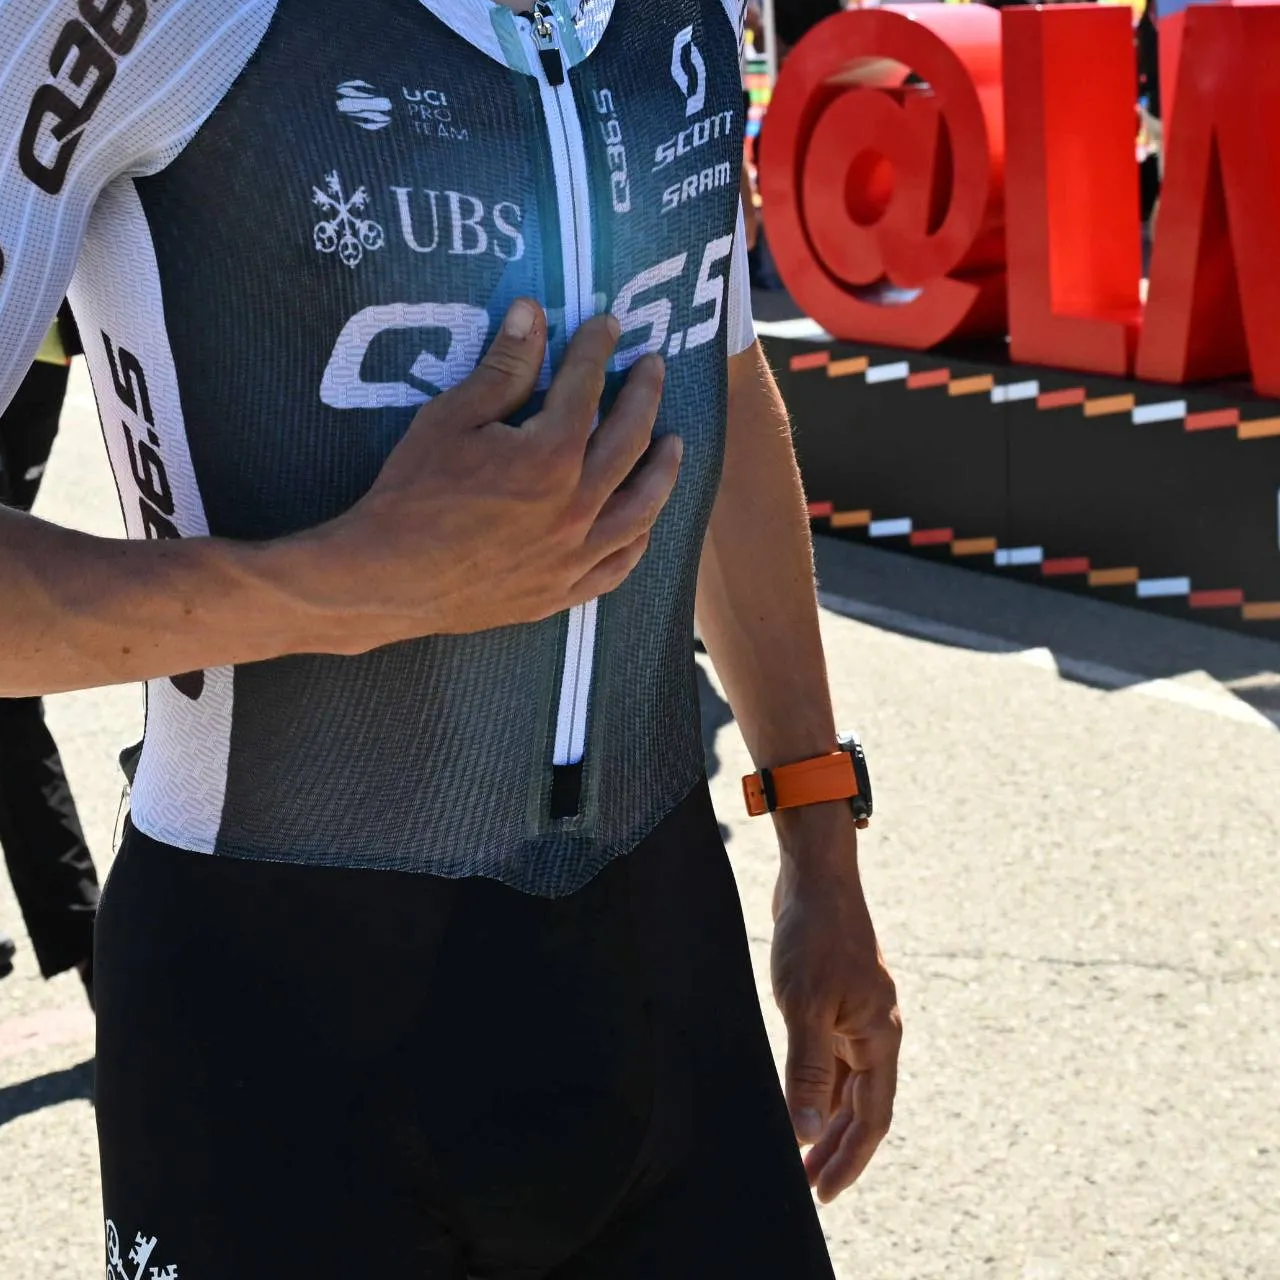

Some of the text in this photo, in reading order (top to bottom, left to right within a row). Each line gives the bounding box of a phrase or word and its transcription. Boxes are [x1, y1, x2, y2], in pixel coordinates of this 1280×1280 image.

[402, 86, 448, 106] UCI
[408, 103, 452, 122] PRO
[414, 120, 469, 142] TEAM
[651, 110, 734, 173] SCOTT
[660, 161, 731, 214] SRAM
[389, 186, 526, 261] UBS
